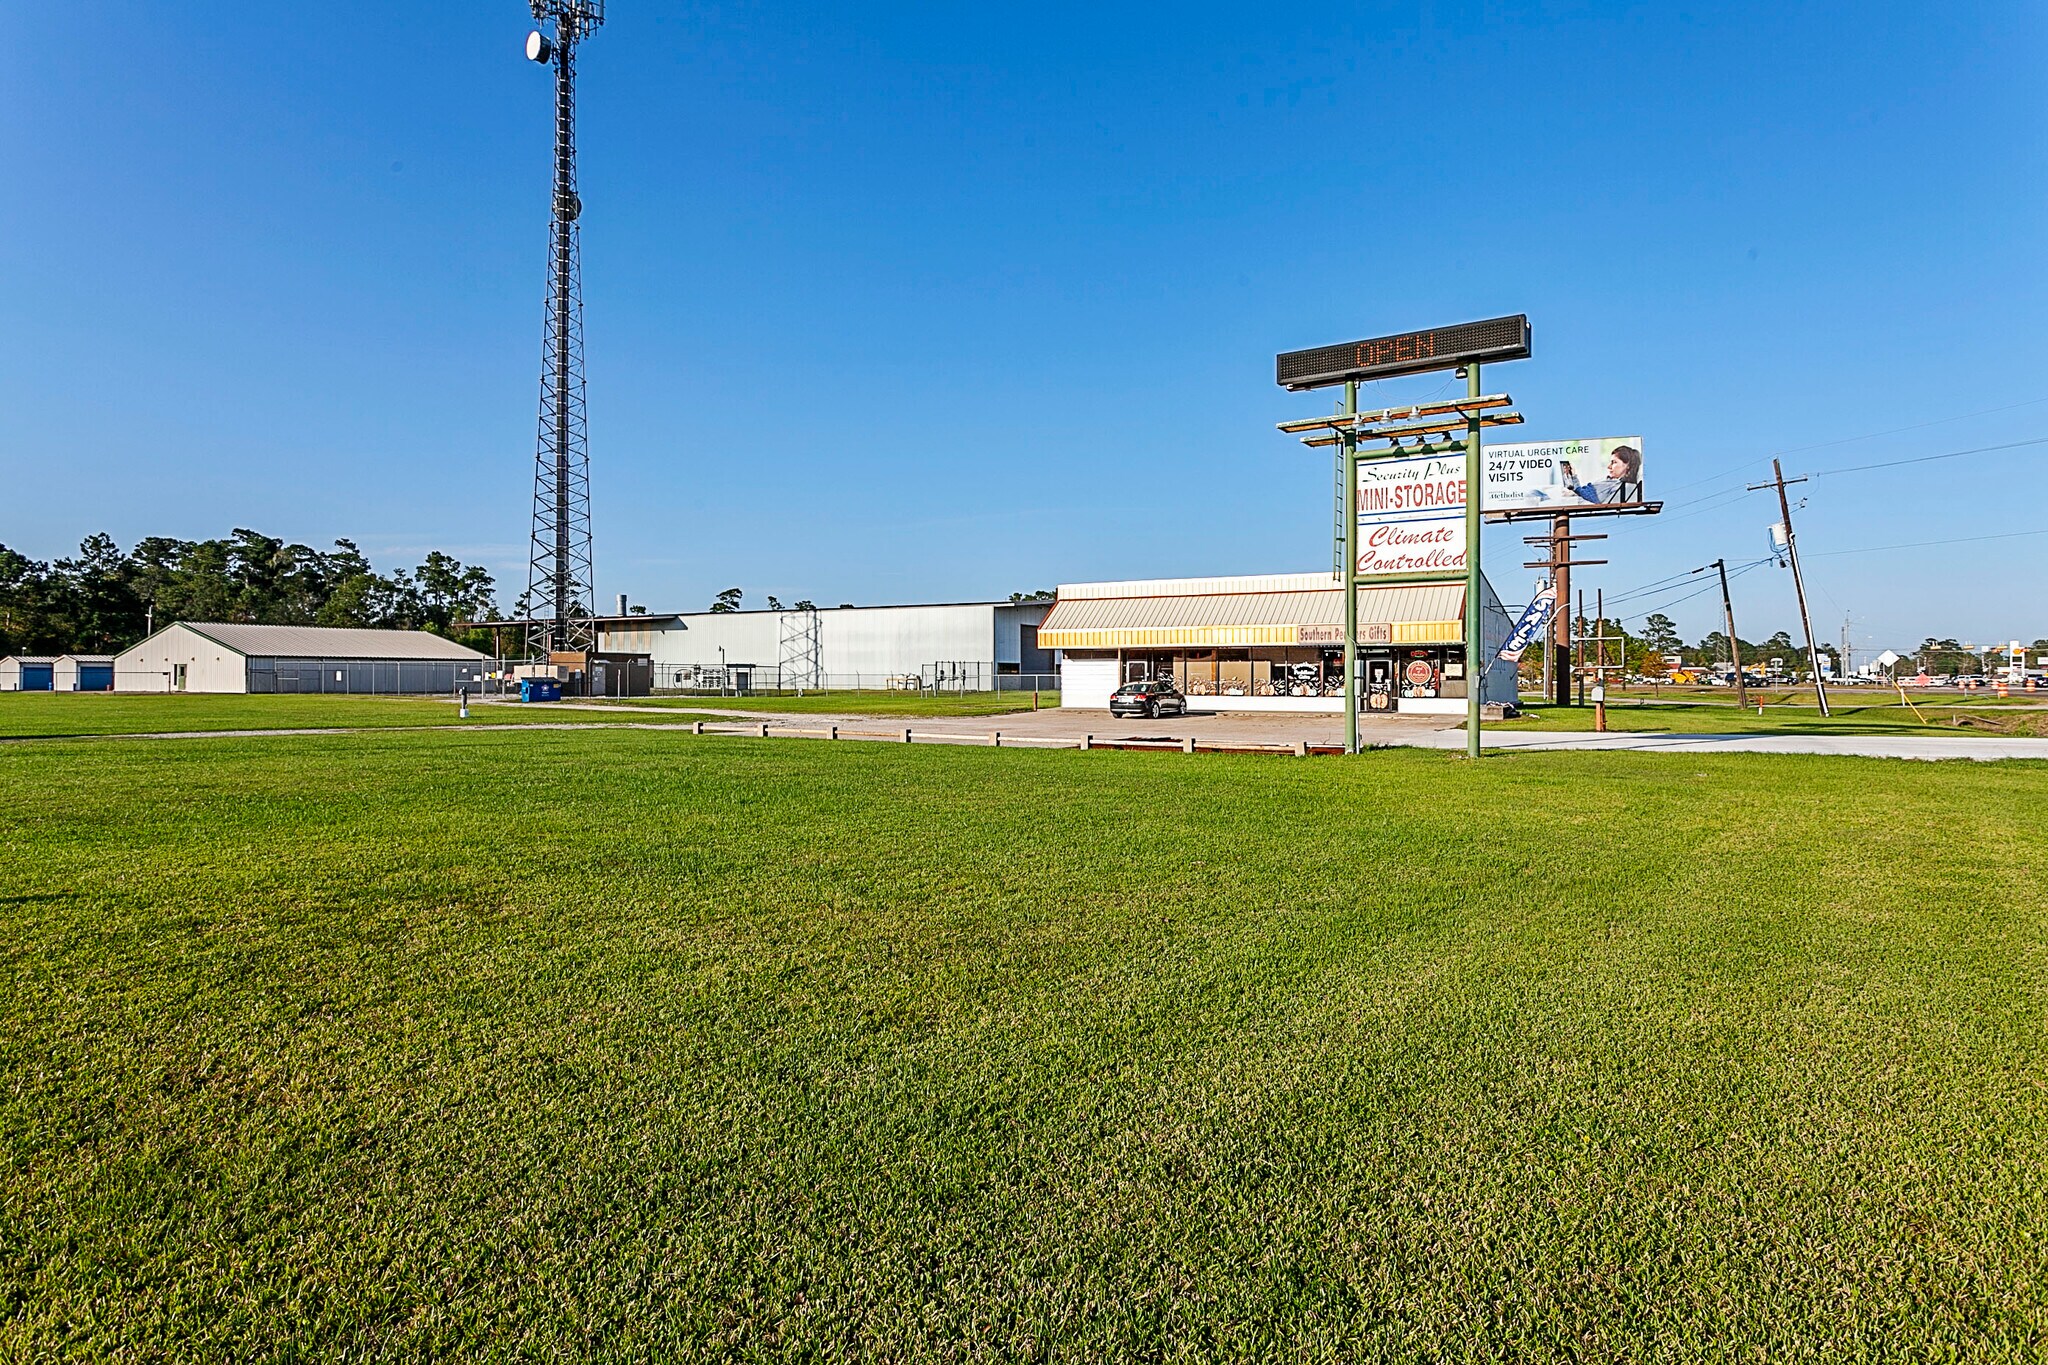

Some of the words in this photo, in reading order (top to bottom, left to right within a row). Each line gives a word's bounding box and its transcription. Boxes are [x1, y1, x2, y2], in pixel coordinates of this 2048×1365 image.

[1356, 332, 1434, 367] OPEN
[1488, 450, 1525, 459] VIRTUAL
[1527, 447, 1563, 457] URGENT
[1565, 445, 1589, 455] CARE
[1362, 467, 1419, 482] Security
[1424, 461, 1461, 480] Plus
[1488, 460, 1515, 471] 24/7
[1519, 458, 1553, 469] VIDEO
[1488, 471, 1524, 483] VISITS
[1357, 480, 1467, 511] MINI-STORAGE
[1369, 526, 1454, 547] Climate
[1357, 548, 1467, 571] Controlled
[1300, 627, 1332, 641] Southern
[1335, 627, 1366, 641] Pers
[1369, 625, 1387, 640] Gifts
[1508, 599, 1554, 651] SALE
